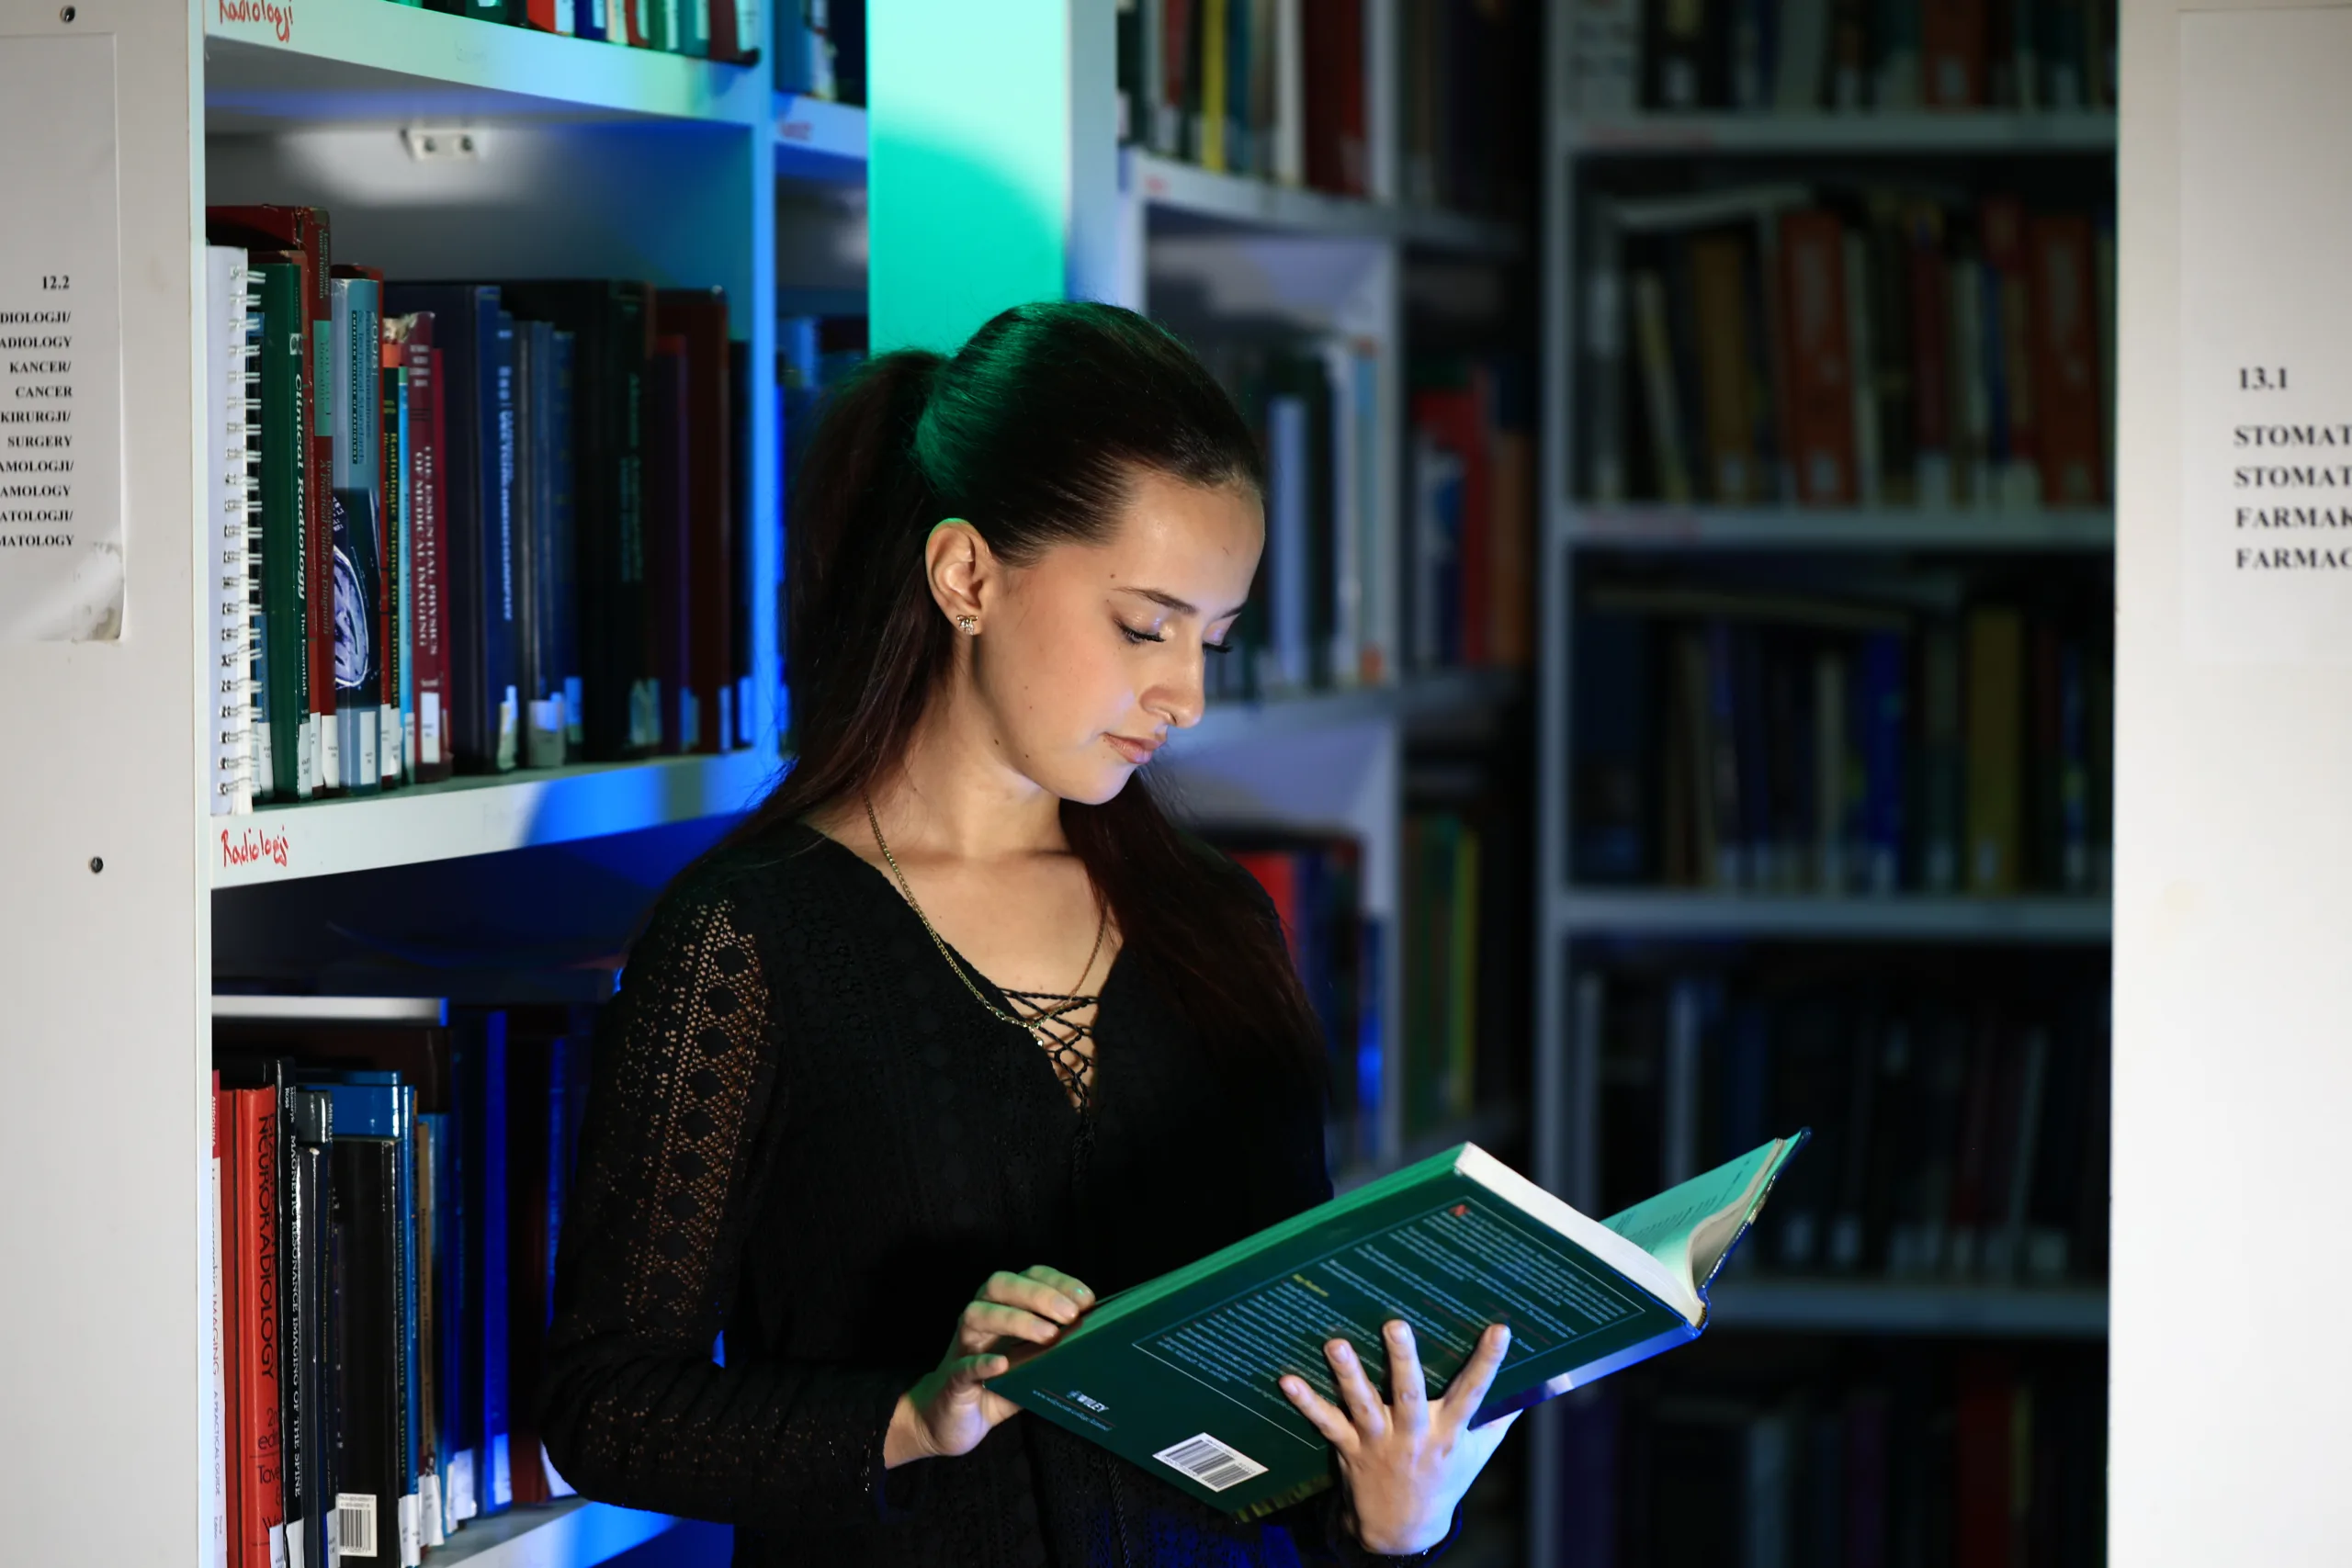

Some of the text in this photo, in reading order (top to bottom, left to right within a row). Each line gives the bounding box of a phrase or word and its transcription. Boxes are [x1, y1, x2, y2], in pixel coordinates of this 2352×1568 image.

[42, 275, 70, 291] 12.2
[371, 311, 379, 368] 2008
[9, 361, 72, 374] KANCER/
[16, 386, 73, 399] CANCER
[2239, 367, 2288, 389] 13.1
[0, 411, 72, 423] KIRURGJI/
[7, 435, 73, 448] SURGERY
[357, 398, 366, 465] Standards
[2233, 424, 2352, 446] STOMAT
[295, 373, 306, 601] Clinical Radiology
[2233, 466, 2352, 488] STOMAT
[320, 526, 329, 563] Guide
[414, 451, 428, 647] OF MEDICAL IMAGING
[424, 483, 436, 581] ESSENTIAL
[322, 580, 332, 635] Diagnosis
[427, 584, 438, 656] PHYSICS
[300, 638, 309, 697] Essentials
[290, 1134, 299, 1217] MAGNETIC
[258, 1115, 275, 1380] NEURORADIOLOGY
[291, 1221, 300, 1313] RESONANCE
[292, 1316, 300, 1386] IMAGING
[294, 1390, 300, 1413] OF
[1077, 1393, 1109, 1413] WILEY
[294, 1452, 302, 1497] SPINE
